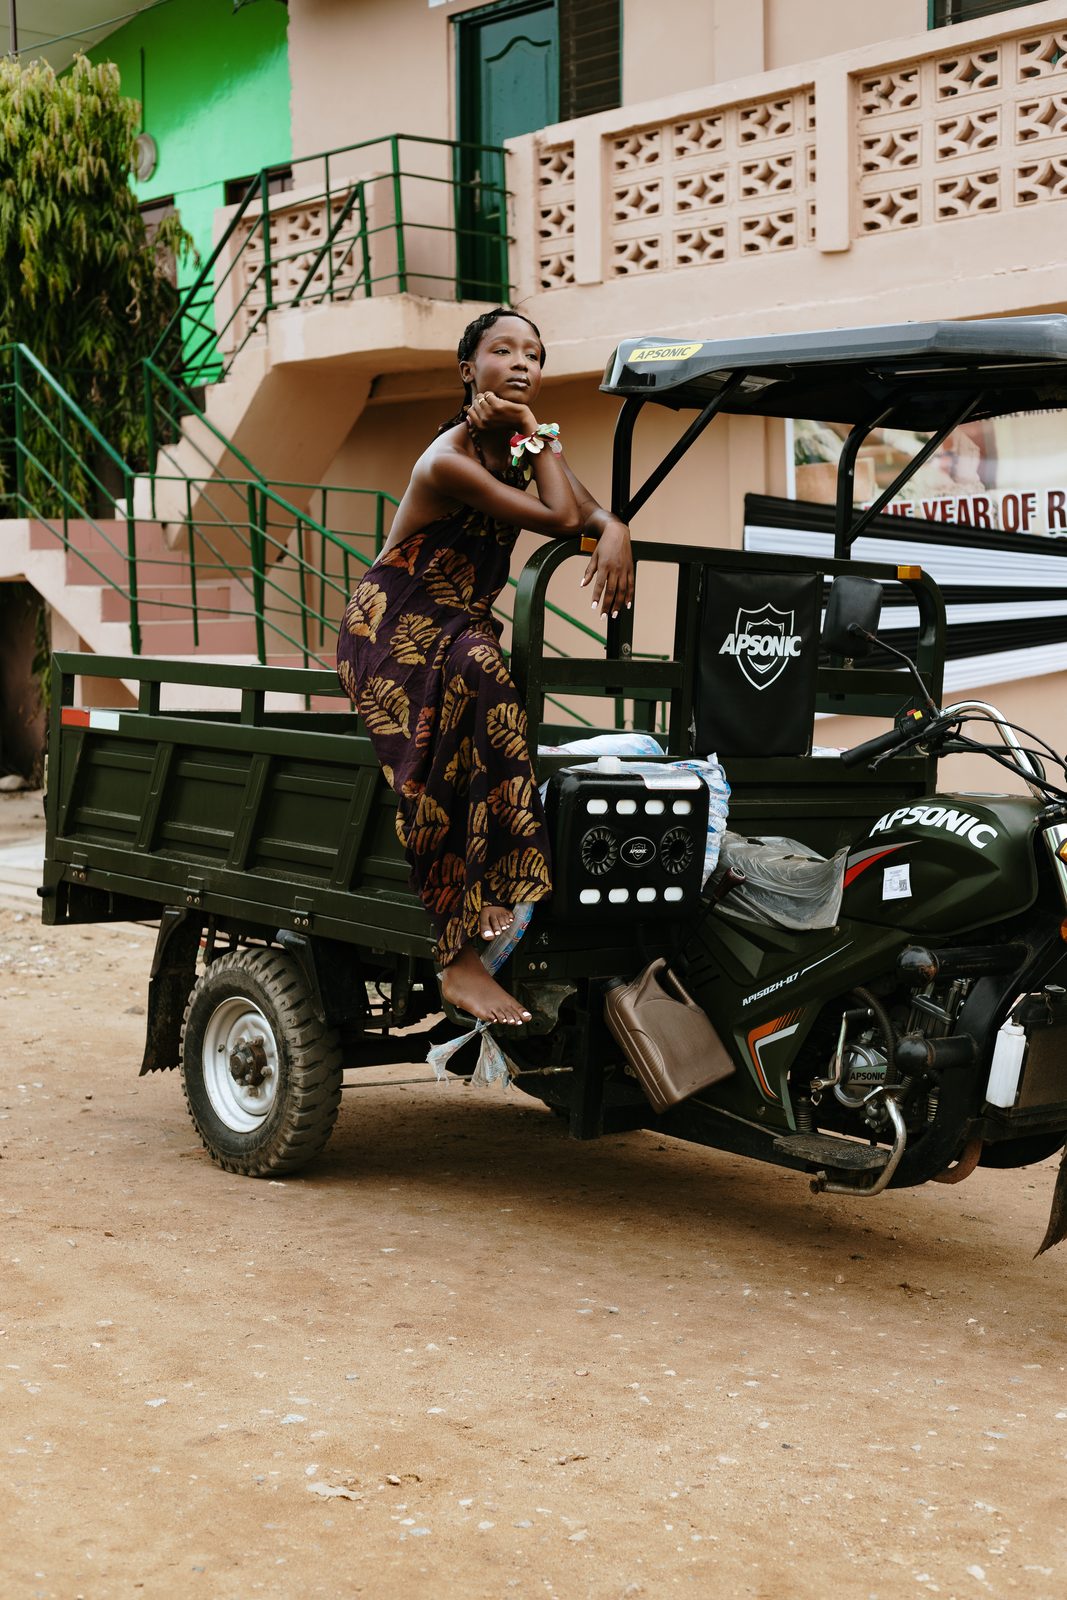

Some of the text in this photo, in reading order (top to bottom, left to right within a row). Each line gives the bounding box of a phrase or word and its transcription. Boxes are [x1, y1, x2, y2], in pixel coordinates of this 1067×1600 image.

[635, 346, 691, 360] APSONIC
[922, 497, 992, 529] YEAR
[1001, 492, 1036, 533] OF
[718, 633, 802, 657] APSONIC
[869, 806, 998, 849] APSONIC
[850, 1072, 885, 1080] APSONIC
